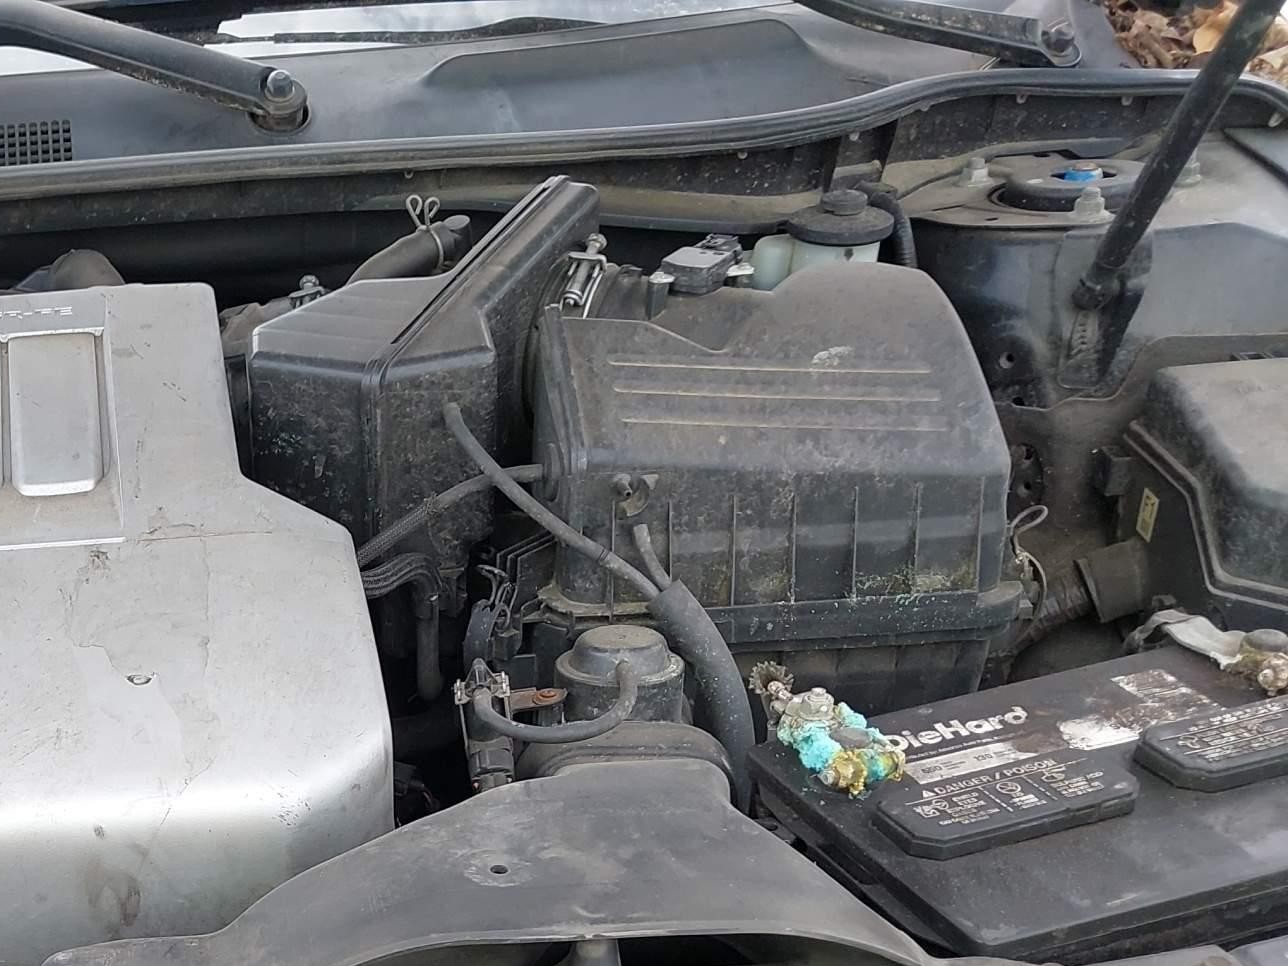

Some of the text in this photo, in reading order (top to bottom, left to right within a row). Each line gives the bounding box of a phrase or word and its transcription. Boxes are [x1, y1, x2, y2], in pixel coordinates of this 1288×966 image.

[884, 705, 1029, 752] DieHard
[934, 774, 993, 794] DANGER
[1003, 758, 1058, 777] POISON
